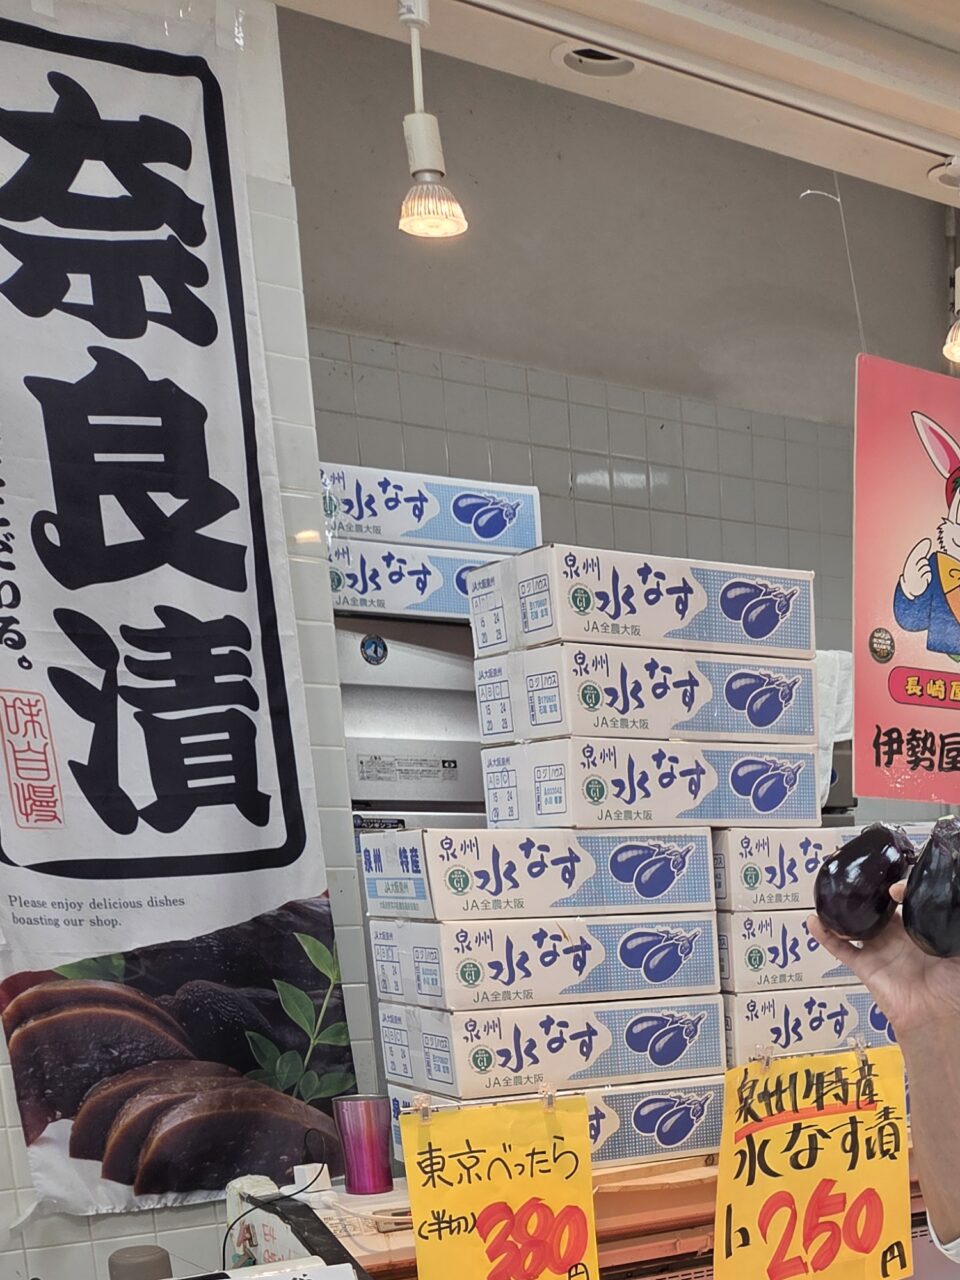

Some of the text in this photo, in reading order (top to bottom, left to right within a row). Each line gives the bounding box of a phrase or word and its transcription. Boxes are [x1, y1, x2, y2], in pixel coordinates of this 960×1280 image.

[0, 70, 272, 838] 奈良漬
[341, 477, 429, 523] 水なす
[345, 551, 431, 595] 水なす
[563, 552, 601, 581] 泉州
[595, 562, 694, 621] 水なす
[584, 620, 641, 637] JA全農大阪
[572, 650, 609, 677] 泉州
[604, 657, 699, 715] 水なす
[593, 717, 649, 730] JA全農大阪
[580, 744, 617, 769] 泉州
[611, 748, 706, 805] 水なす
[597, 808, 653, 822] JA全農大阪
[439, 836, 479, 861] 泉州
[739, 835, 771, 858] 泉州
[474, 837, 581, 897] 水なす
[8, 895, 186, 913] Please enjoy delicious dishes
[462, 898, 525, 911] JA全農大阪
[752, 893, 800, 904] JA全農大阪
[12, 914, 123, 929] boasting our shop.
[742, 917, 773, 940] 泉州
[454, 928, 493, 953] 泉州
[487, 927, 592, 986] 水なす
[757, 972, 804, 986] JA全農大阪
[473, 989, 534, 1004] JA全農大阪
[745, 999, 776, 1022] 泉州
[770, 996, 849, 1049] 水なす
[463, 1017, 502, 1043] 泉州
[496, 1014, 598, 1073] 水なす
[485, 1074, 545, 1089] JA全農大阪
[736, 1060, 880, 1123] 泉州特産
[734, 1106, 903, 1186] 水なす漬
[416, 1134, 580, 1190] 東京べったら
